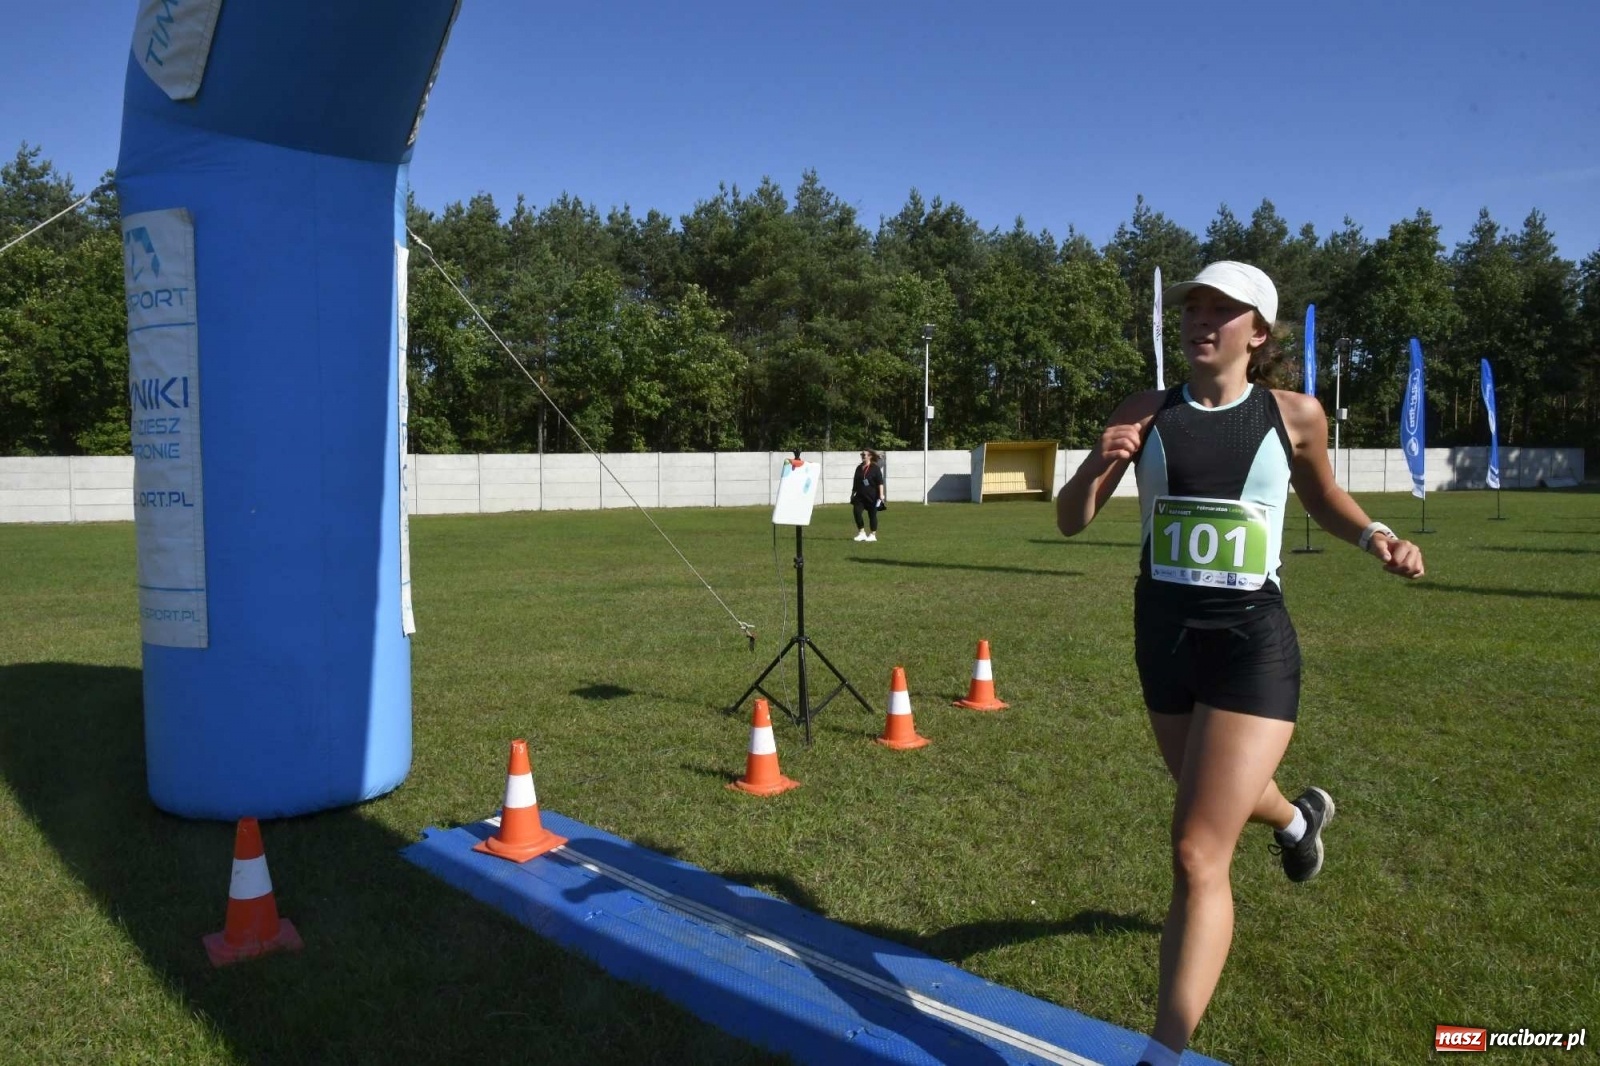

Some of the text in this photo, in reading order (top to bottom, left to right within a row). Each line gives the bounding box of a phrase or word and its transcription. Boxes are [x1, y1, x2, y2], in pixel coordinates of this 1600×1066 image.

[133, 442, 180, 460] RONIE
[134, 491, 194, 508] ORT.PL
[1163, 521, 1247, 567] 101
[141, 607, 201, 623] SPORT.PL
